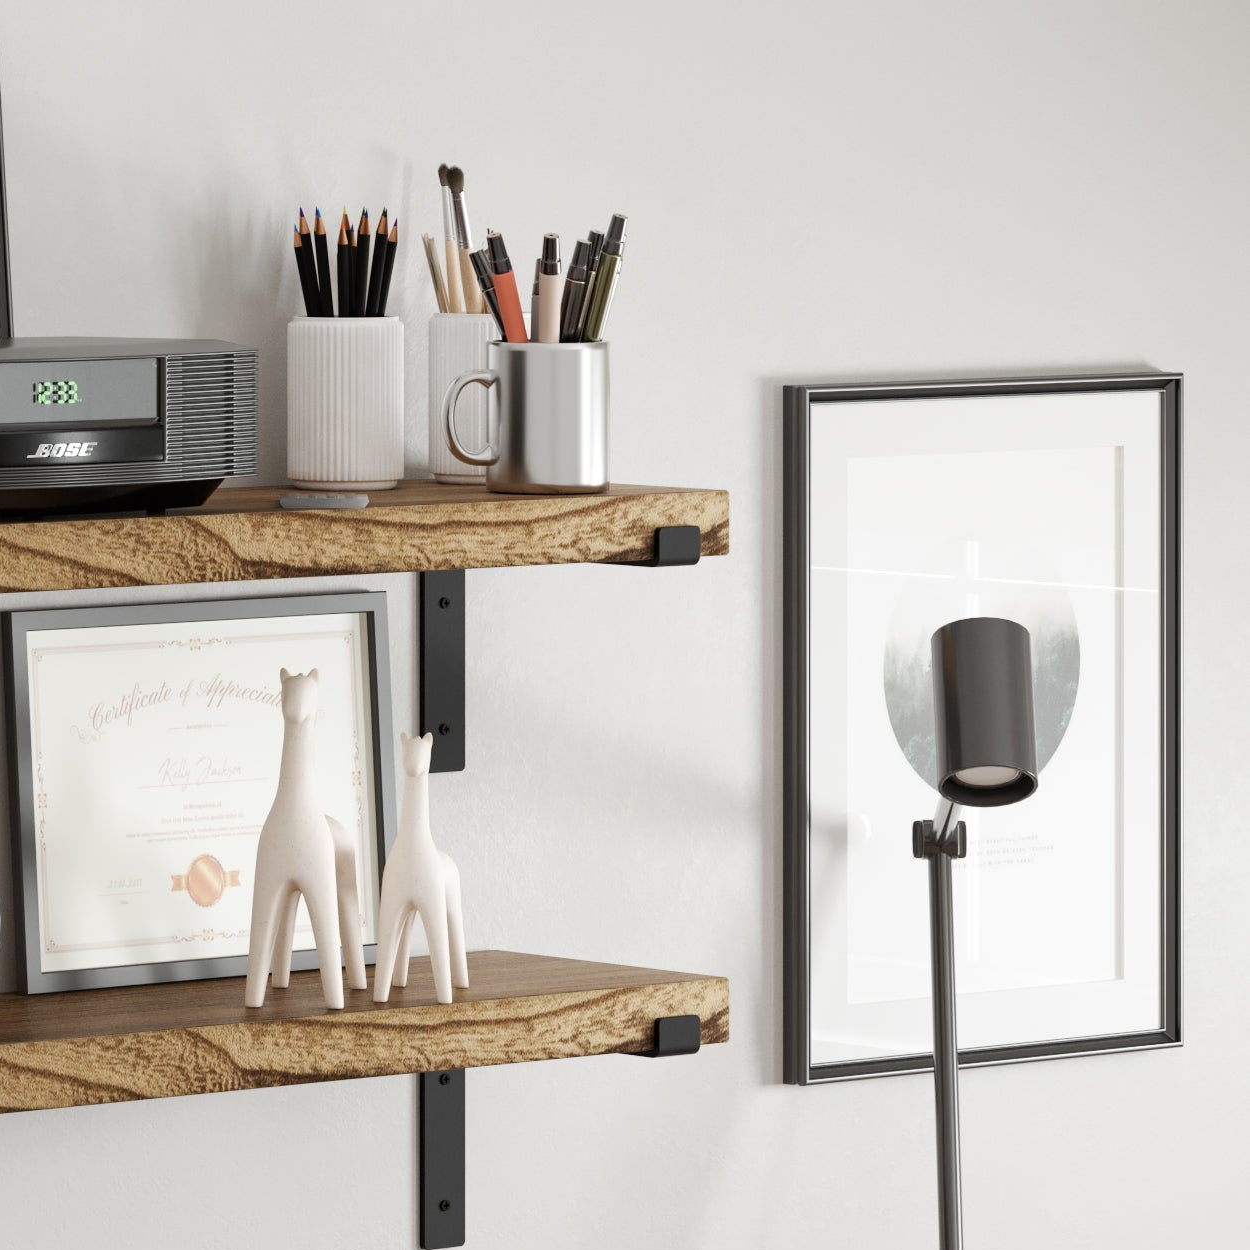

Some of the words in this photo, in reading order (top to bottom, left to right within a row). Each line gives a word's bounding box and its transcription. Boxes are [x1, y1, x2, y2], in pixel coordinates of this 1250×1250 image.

[38, 381, 78, 404] 12:33
[27, 442, 98, 459] BOSE
[88, 681, 173, 731] Certificate
[179, 679, 195, 706] of
[196, 673, 282, 708] Appreciat
